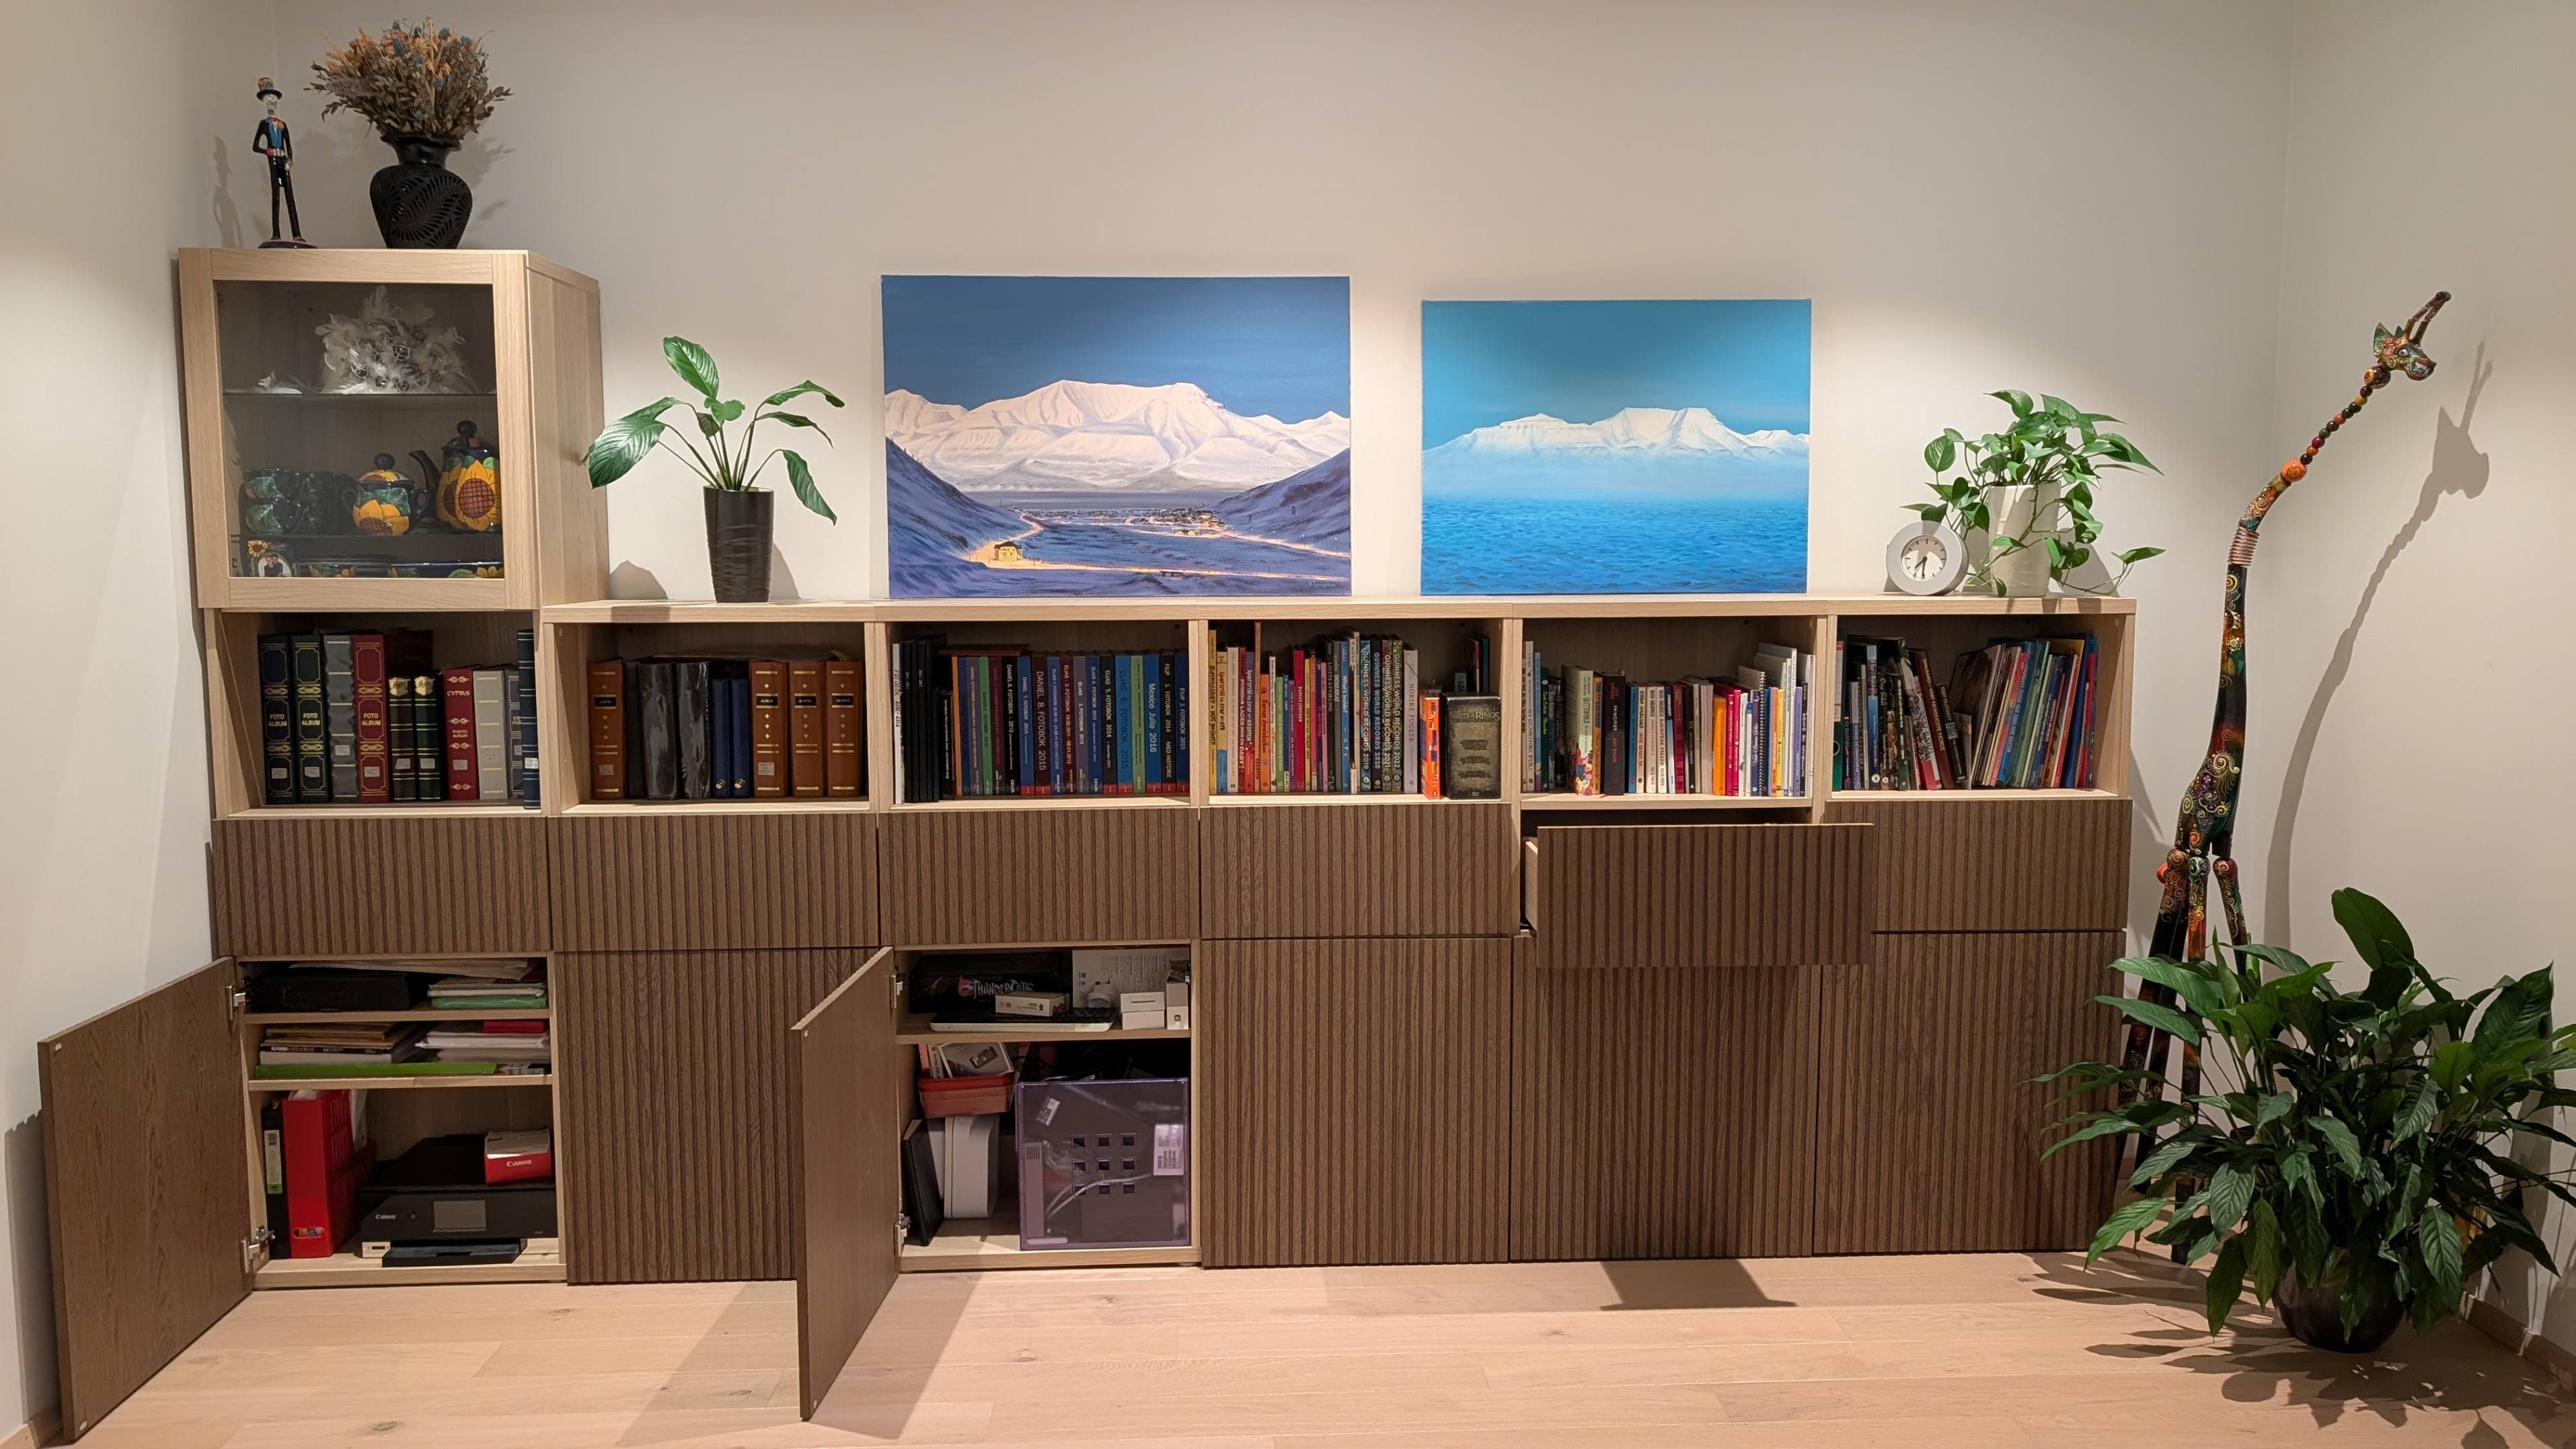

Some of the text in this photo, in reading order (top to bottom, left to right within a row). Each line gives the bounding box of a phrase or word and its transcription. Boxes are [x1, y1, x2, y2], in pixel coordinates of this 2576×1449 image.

[1036, 671, 1045, 698] DANIEL
[1476, 710, 1501, 721] RINGS
[1922, 659, 1932, 683] SVALBARD
[1937, 733, 1946, 751] NORGE
[1038, 712, 1046, 747] FOTOBOK
[973, 979, 1034, 1000] THUNDERCATS
